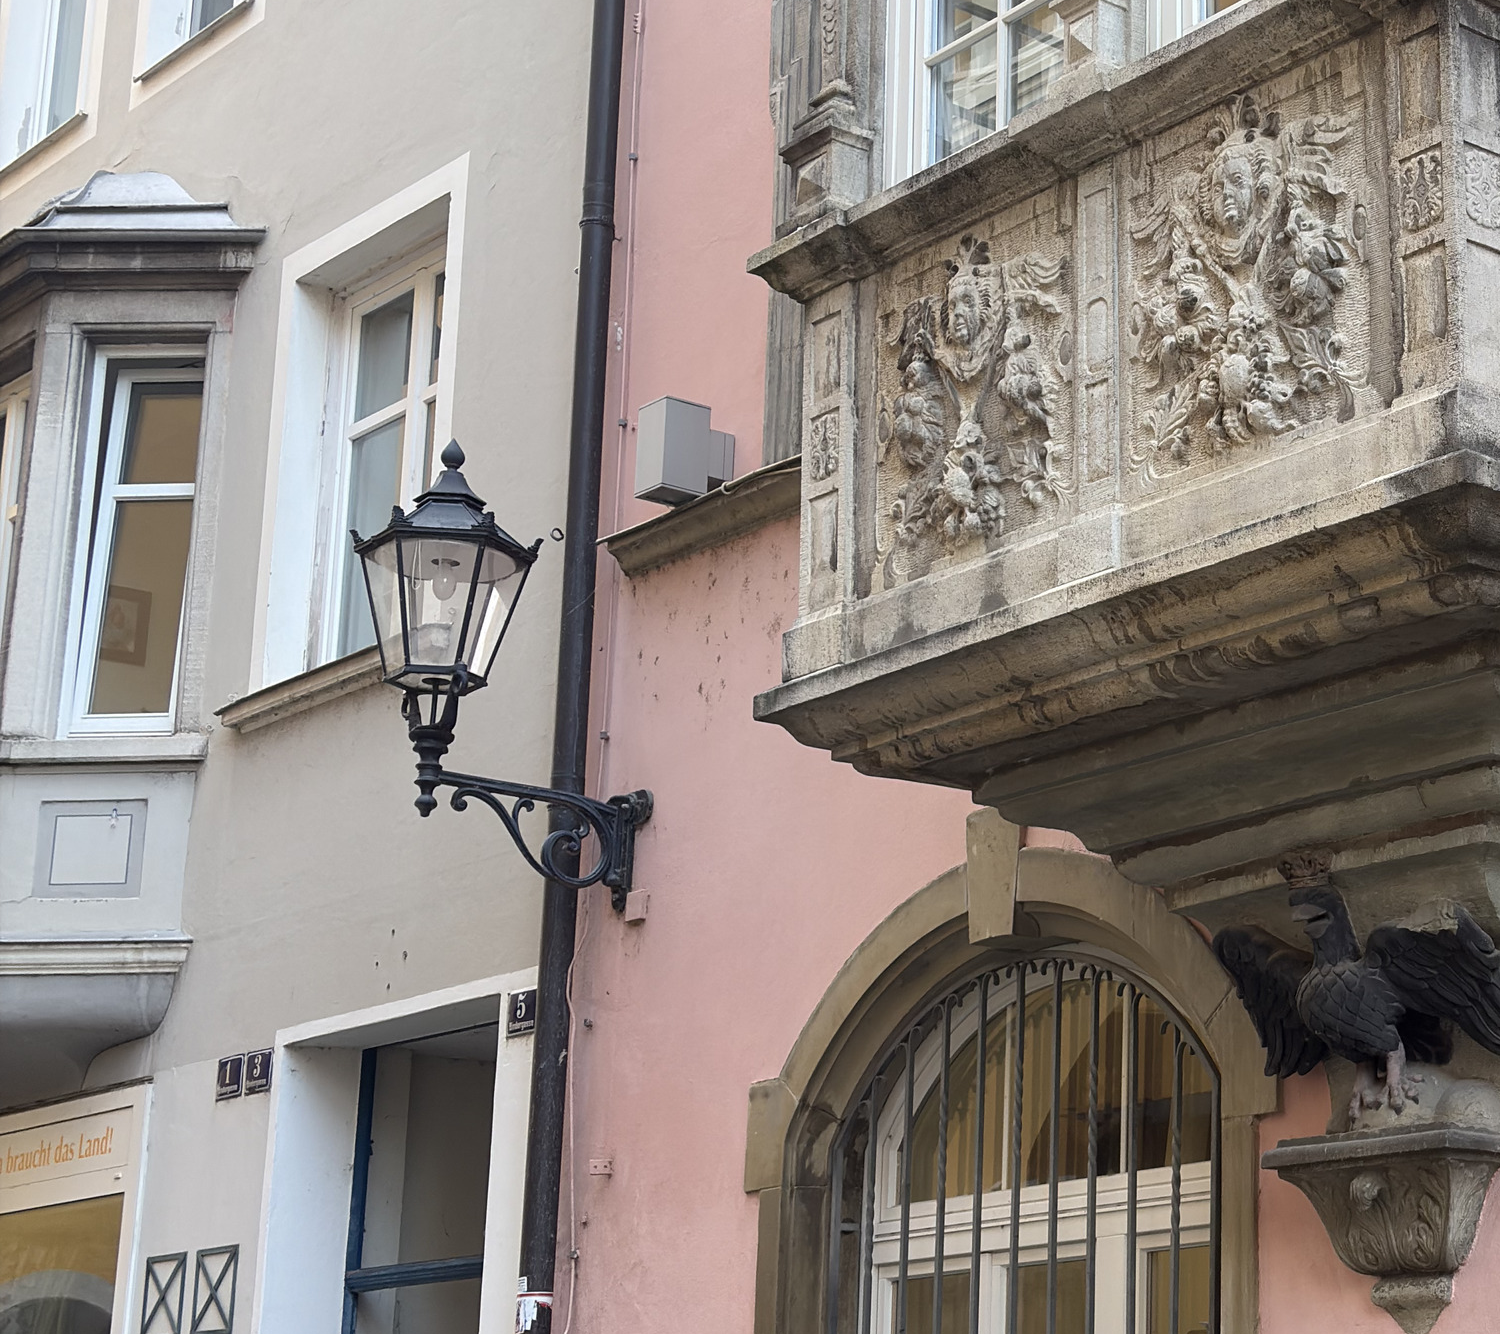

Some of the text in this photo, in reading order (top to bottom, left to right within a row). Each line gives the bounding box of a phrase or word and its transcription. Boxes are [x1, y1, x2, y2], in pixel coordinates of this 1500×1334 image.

[516, 993, 528, 1019] 5
[224, 1060, 231, 1084] 1
[253, 1055, 262, 1077] 3
[5, 1140, 51, 1174] braucht
[54, 1135, 75, 1163] das
[78, 1126, 114, 1158] Land!
